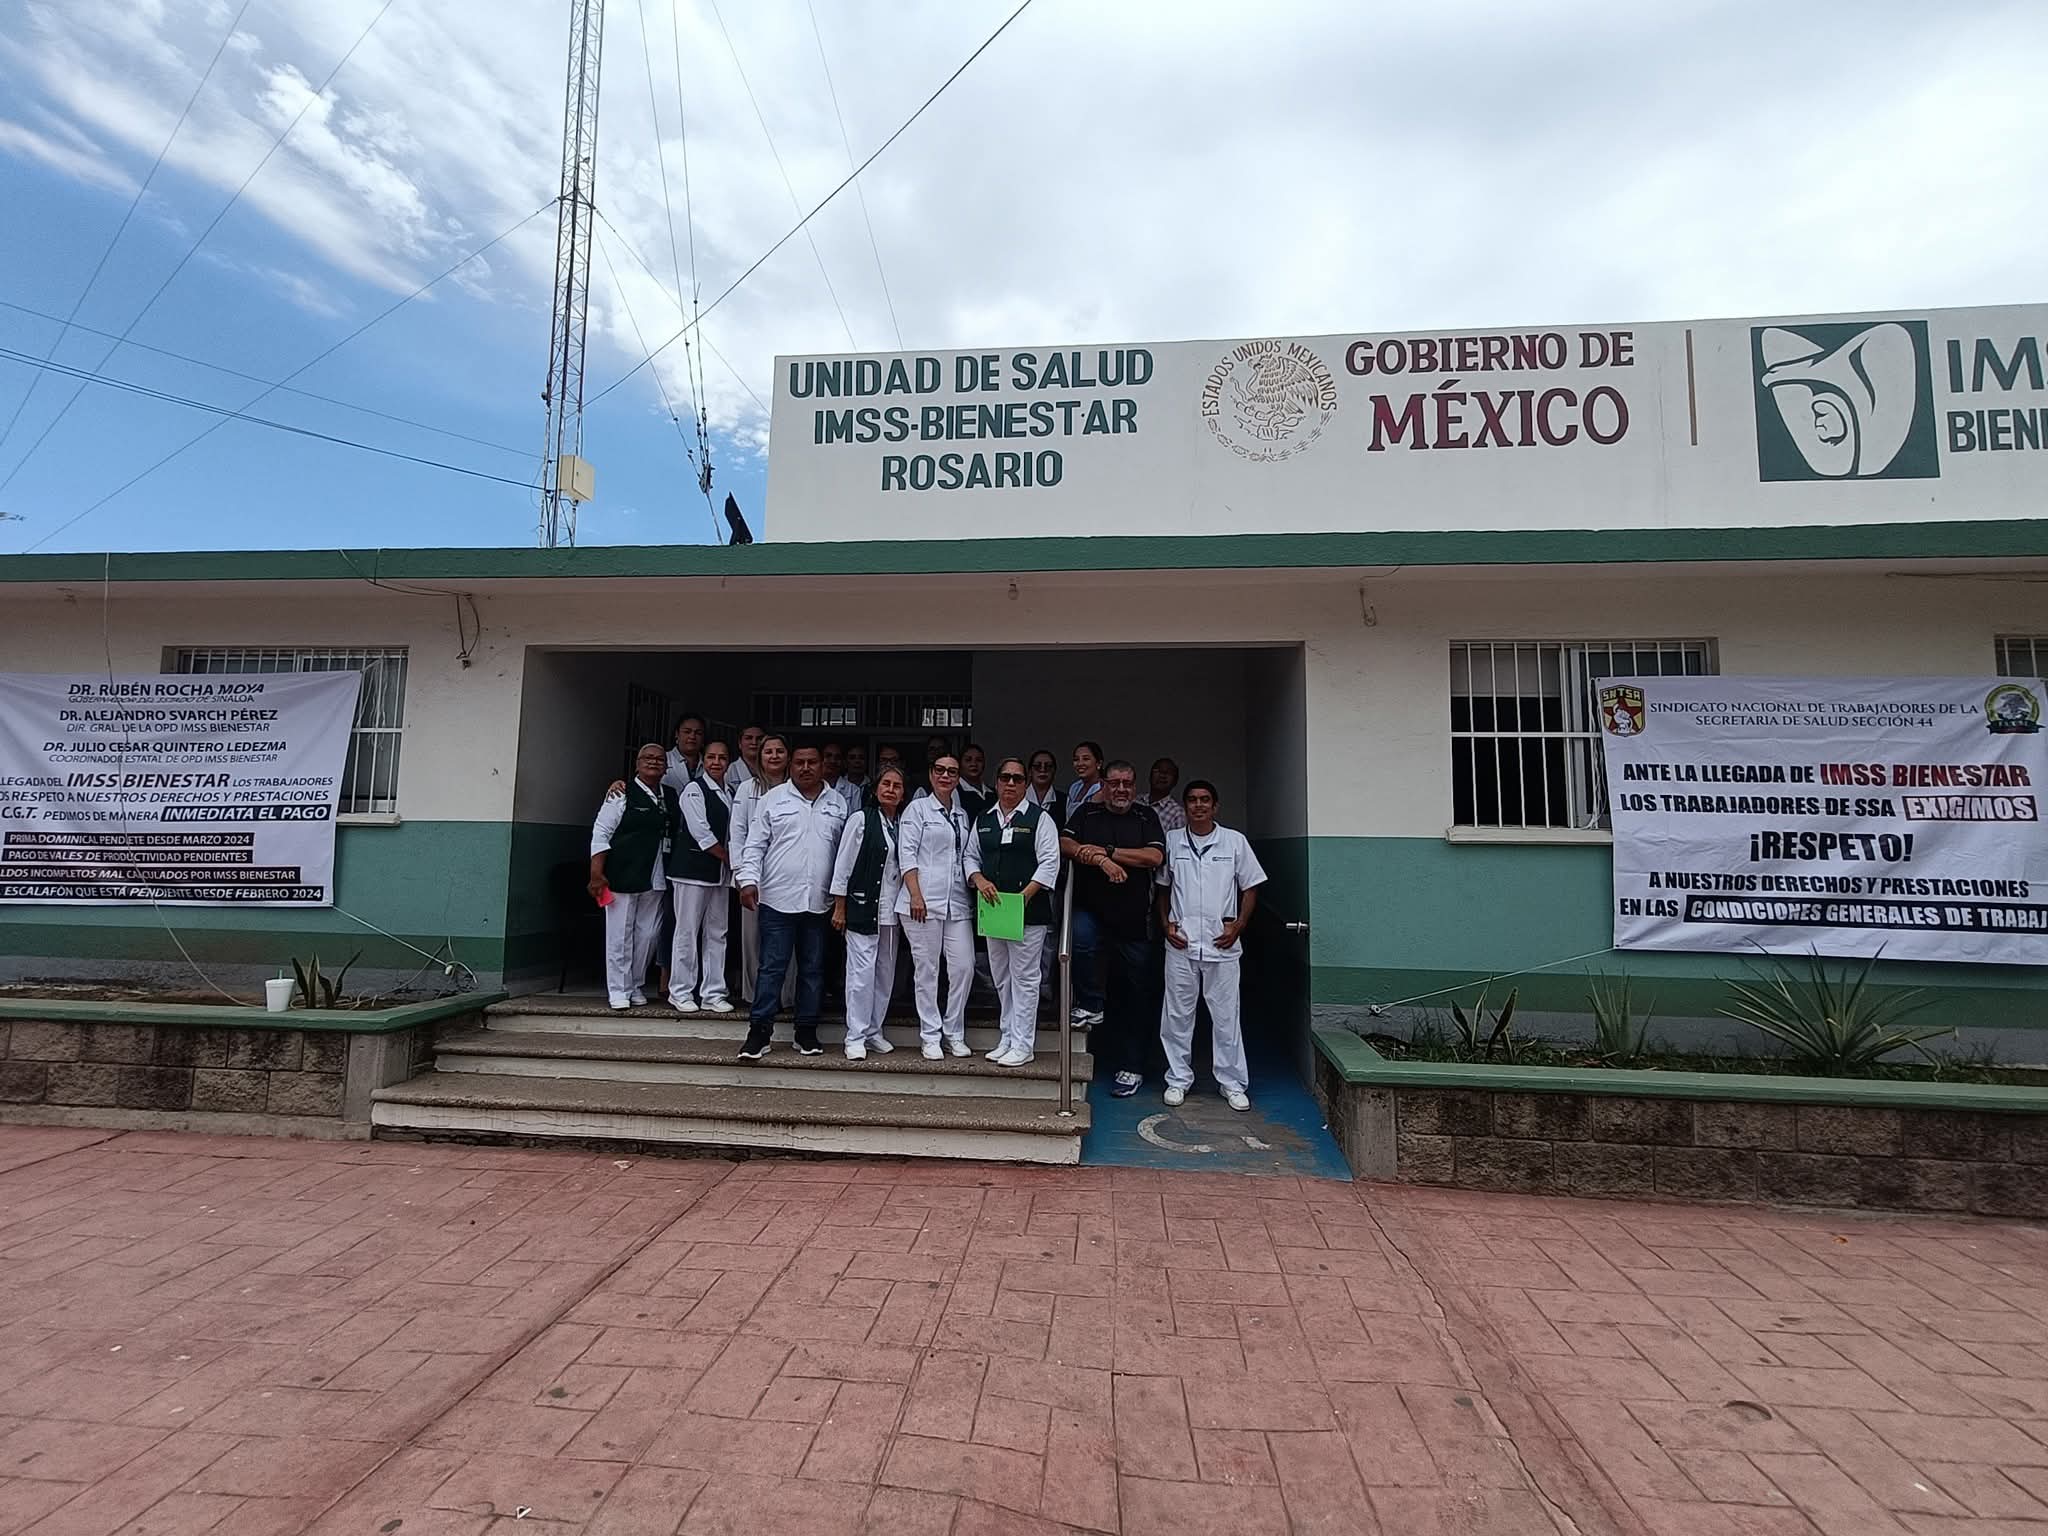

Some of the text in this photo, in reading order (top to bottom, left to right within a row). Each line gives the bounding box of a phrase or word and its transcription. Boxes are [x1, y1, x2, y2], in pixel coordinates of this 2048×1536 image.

[1345, 332, 1634, 376] GOBIERNO DE
[1947, 336, 2048, 393] IM
[789, 349, 1154, 398] UNIDAD DE SALUD
[1202, 340, 1337, 417] ESTADOS UNIDOS MEXICANOS
[814, 400, 1138, 444] IMSS-BIENESTAR
[1367, 379, 1630, 451] MÉXICO
[881, 450, 1064, 492] ROSARIO
[67, 682, 265, 697] DR. RUBÉN ROCHA MOYA
[1602, 688, 1641, 700] SNTSA
[210, 694, 255, 703] SINALOA
[59, 708, 278, 721] DR. ALEJANDRO SVARCH PÉREZ
[1650, 702, 1979, 715] SINDICATO NACIONAL DE TRABAJADORES DE LA
[122, 723, 137, 733] DE
[139, 723, 152, 733] LA
[154, 723, 178, 733] OPD
[181, 723, 207, 733] IMSS
[210, 722, 270, 733] BIENESTAR
[1695, 714, 1933, 727] SECRETARIA DE SALUD SECCIÓN 44
[43, 742, 67, 752] DR.
[70, 742, 106, 752] JULIO
[152, 742, 224, 753] QUINTERO
[227, 741, 287, 752] LEDEZMA
[48, 753, 279, 764] COORDINADOR ESTATAL DE OPD IMSS BIENESTAR
[0, 773, 333, 788] LEGADA DEL IMSS BIENESTAR LOS TRABAJADORES
[1624, 763, 2032, 787] ANTE LA LLEGADA DE IMSS BIENESTAR
[12, 791, 65, 802] RESPETO
[67, 792, 76, 801] A
[77, 792, 147, 803] NUESTROS
[149, 792, 220, 803] DERECHOS
[223, 792, 232, 802] Y
[233, 791, 329, 802] PRESTACIONES
[1, 805, 328, 821] C.G.T. PEDIMOS DE MANERA INMEDIATA EL PAGO
[1620, 793, 2034, 819] LOS TRABAJADORES DE SSA EXIGIMOS
[10, 833, 37, 844] PRIMA
[38, 834, 98, 845] DOMINICAL
[147, 835, 181, 845] DESDE
[182, 835, 222, 845] MARZO
[224, 835, 249, 845] 2024
[1750, 831, 1914, 862] ¡RESPETO!
[8, 850, 248, 862] PAGO DE VALES DE PRODUCTIVIDAD PENDIENTES
[30, 868, 97, 878] INCOMPLETOS
[98, 869, 125, 878] MAL
[190, 871, 211, 880] POR
[213, 871, 238, 880] IMSS
[240, 871, 295, 880] BIENESTAR
[75, 887, 98, 897] QUE
[100, 886, 127, 896] ESTÁ
[129, 886, 194, 898] PENDIENTE
[194, 889, 233, 898] DESDE
[235, 889, 289, 898] FEBRERO
[292, 888, 322, 898] 2024
[1649, 871, 2030, 898] A NUESTROS DERECHOS Y PRESTACIONES
[1620, 898, 2048, 929] EN LAS CONDICIONES GENERALES DE TRABAJ
